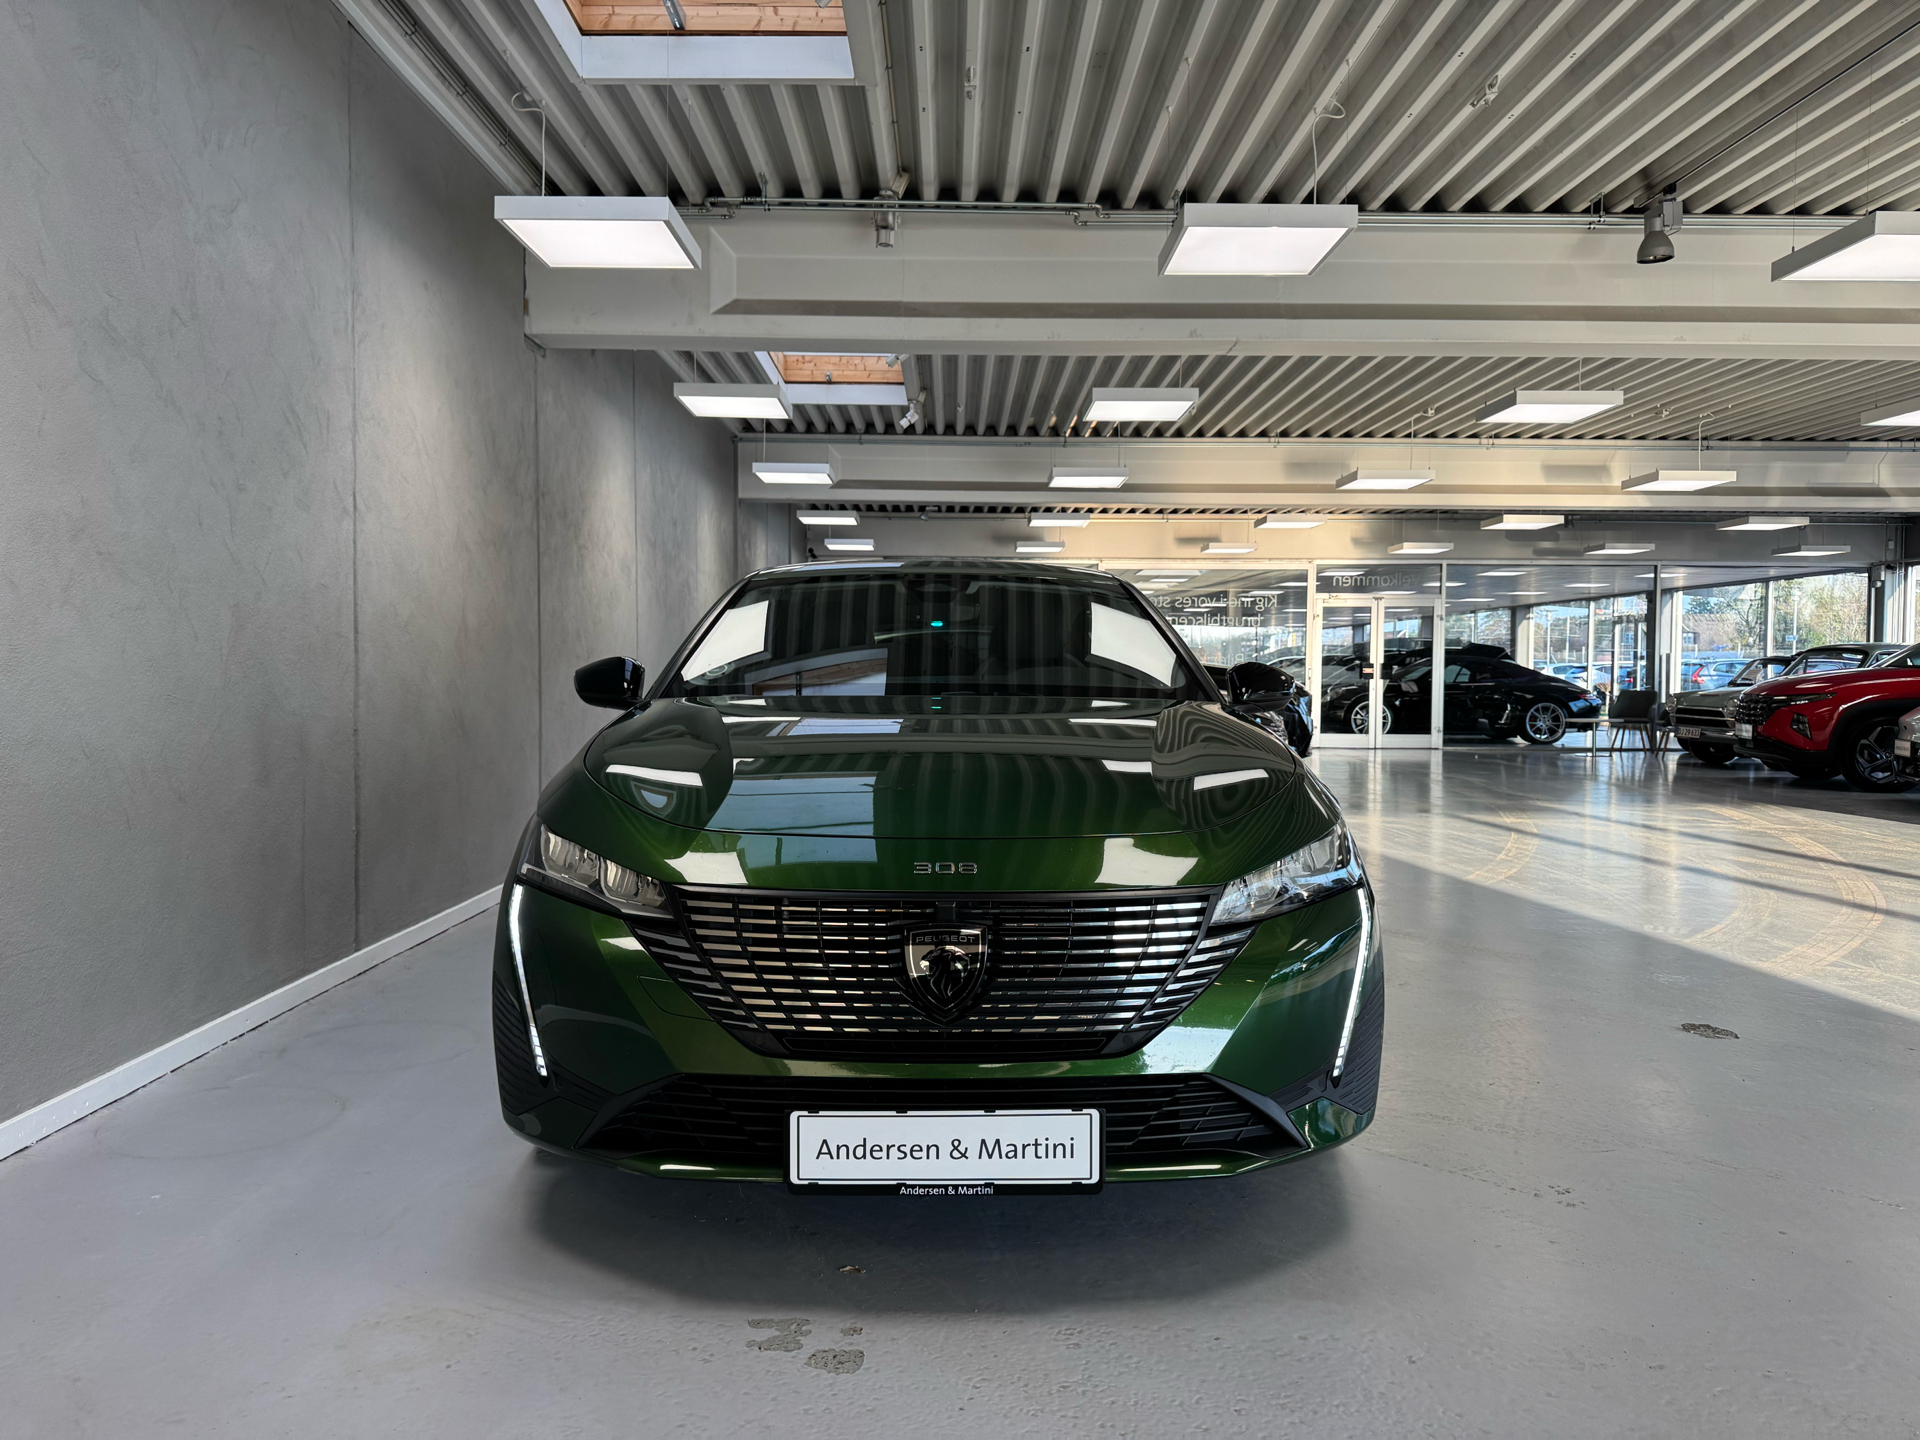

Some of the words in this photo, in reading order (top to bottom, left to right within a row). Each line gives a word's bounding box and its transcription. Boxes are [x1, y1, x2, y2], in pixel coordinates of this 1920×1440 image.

[913, 862, 978, 874] 308
[915, 934, 976, 943] PEUGEOT
[816, 1137, 940, 1160] Andersen
[949, 1138, 969, 1160] &
[978, 1137, 1075, 1160] Martini
[900, 1186, 945, 1195] Andersen
[947, 1186, 956, 1195] &
[957, 1186, 994, 1195] Martini
